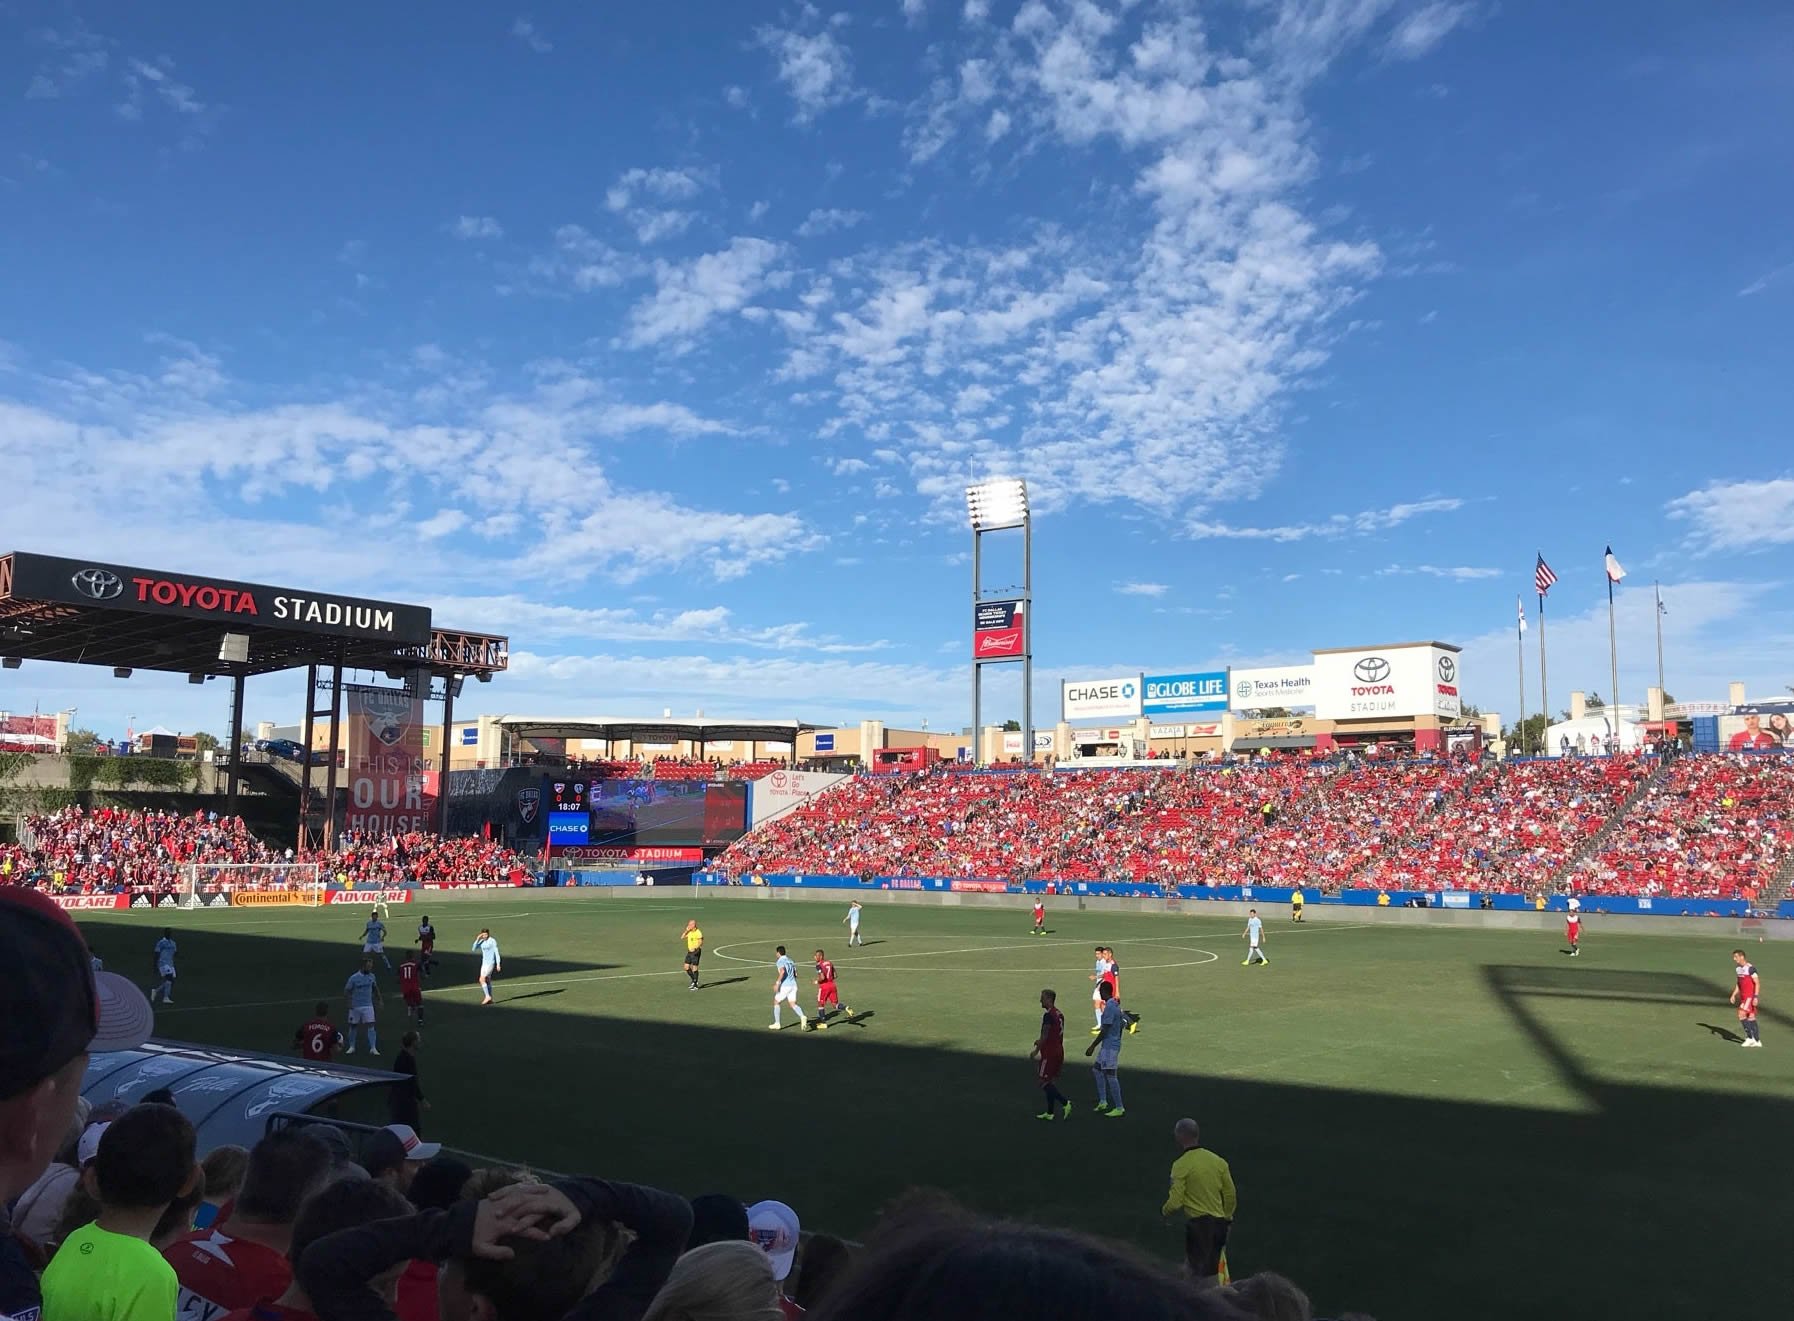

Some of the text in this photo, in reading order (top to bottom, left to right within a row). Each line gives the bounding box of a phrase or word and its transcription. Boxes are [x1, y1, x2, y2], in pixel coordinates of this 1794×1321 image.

[132, 577, 394, 632] TOYOTA STADIUM
[1156, 679, 1223, 698] GLOBE LIFE
[1254, 677, 1311, 689] Texas Health
[1068, 685, 1119, 701] CHASE
[1350, 685, 1395, 697] TOYOTA
[1437, 684, 1458, 697] TOYOTA
[1350, 701, 1396, 712] STADIUM
[648, 733, 677, 742] TOYOTA
[355, 755, 423, 775] THIS IS
[353, 777, 421, 810] OUR
[558, 803, 581, 811] 18:07
[351, 813, 421, 833] HOUSE
[585, 848, 683, 858] TOYOTA STADIUM
[54, 896, 116, 908] VOCARE
[234, 893, 291, 906] Continental
[332, 891, 405, 903] ADVOCRE
[403, 966, 412, 979] 11
[825, 965, 831, 979] 7
[311, 1033, 324, 1053] 6
